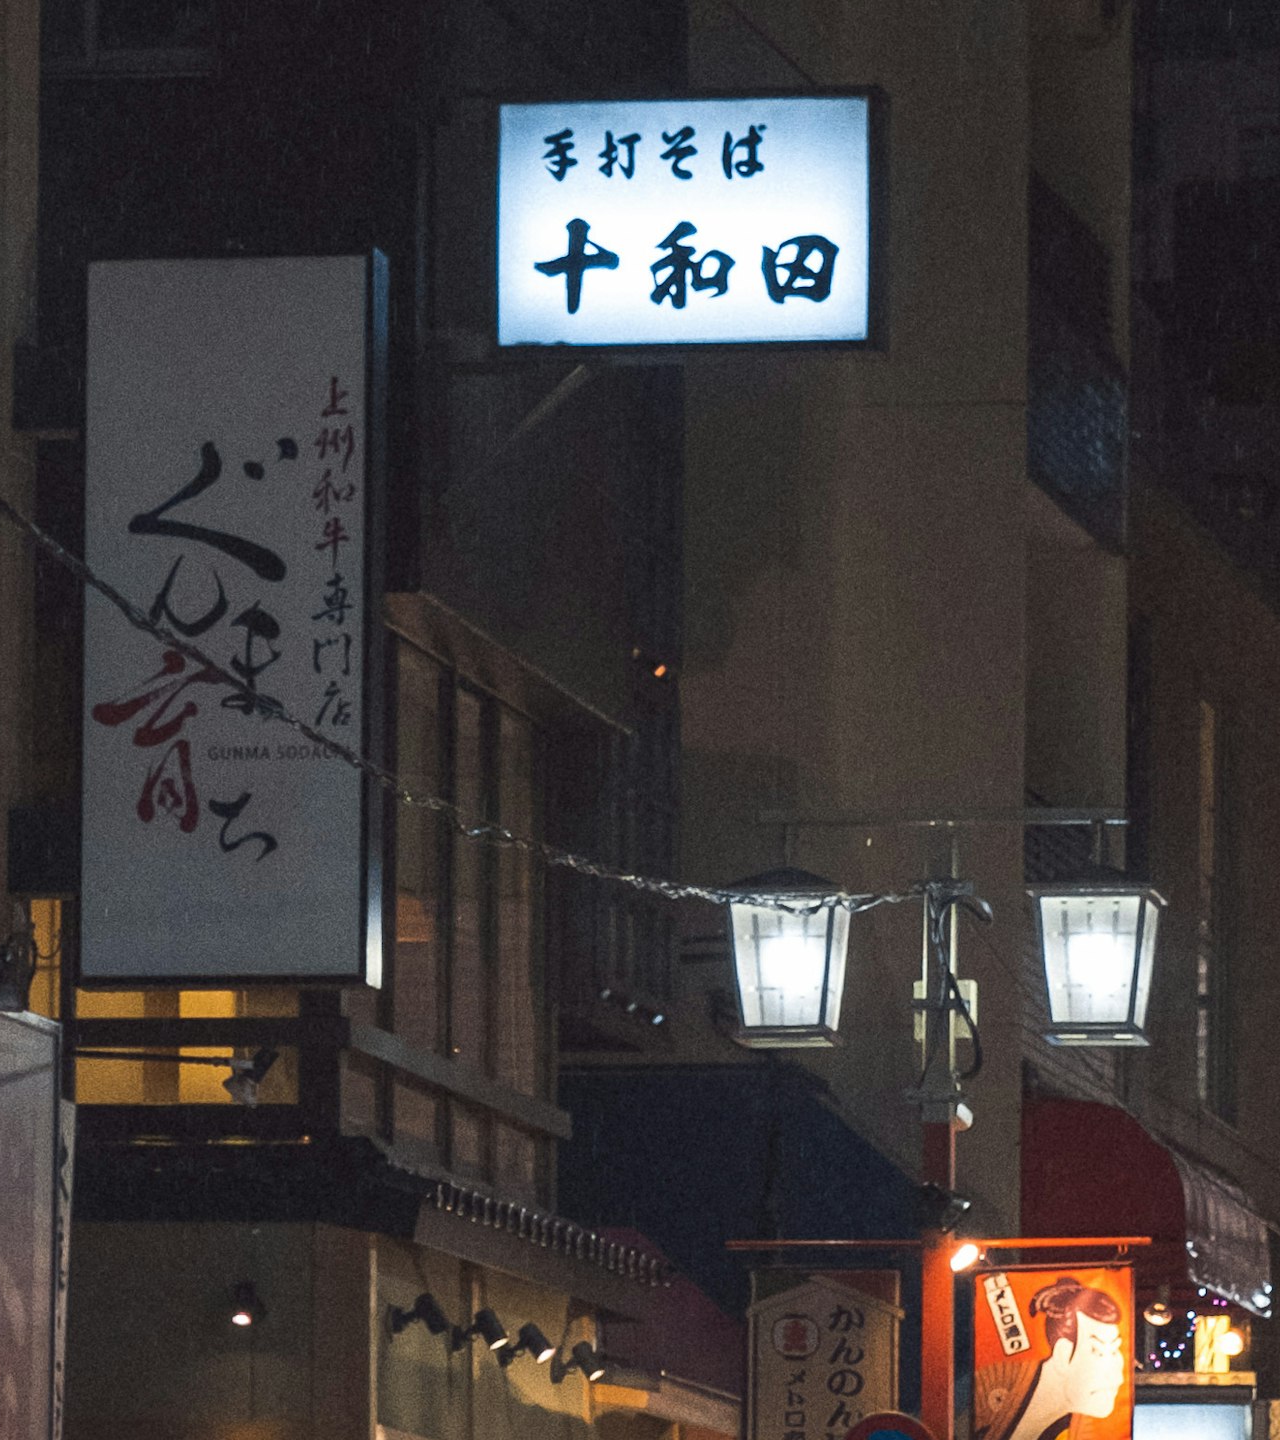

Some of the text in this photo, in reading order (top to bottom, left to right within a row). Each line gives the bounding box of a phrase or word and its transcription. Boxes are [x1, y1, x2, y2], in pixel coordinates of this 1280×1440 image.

[541, 124, 768, 181] 手打そば
[533, 217, 841, 316] 十和田
[311, 375, 358, 728] 上州和牛専門店
[207, 744, 272, 762] GUNMA
